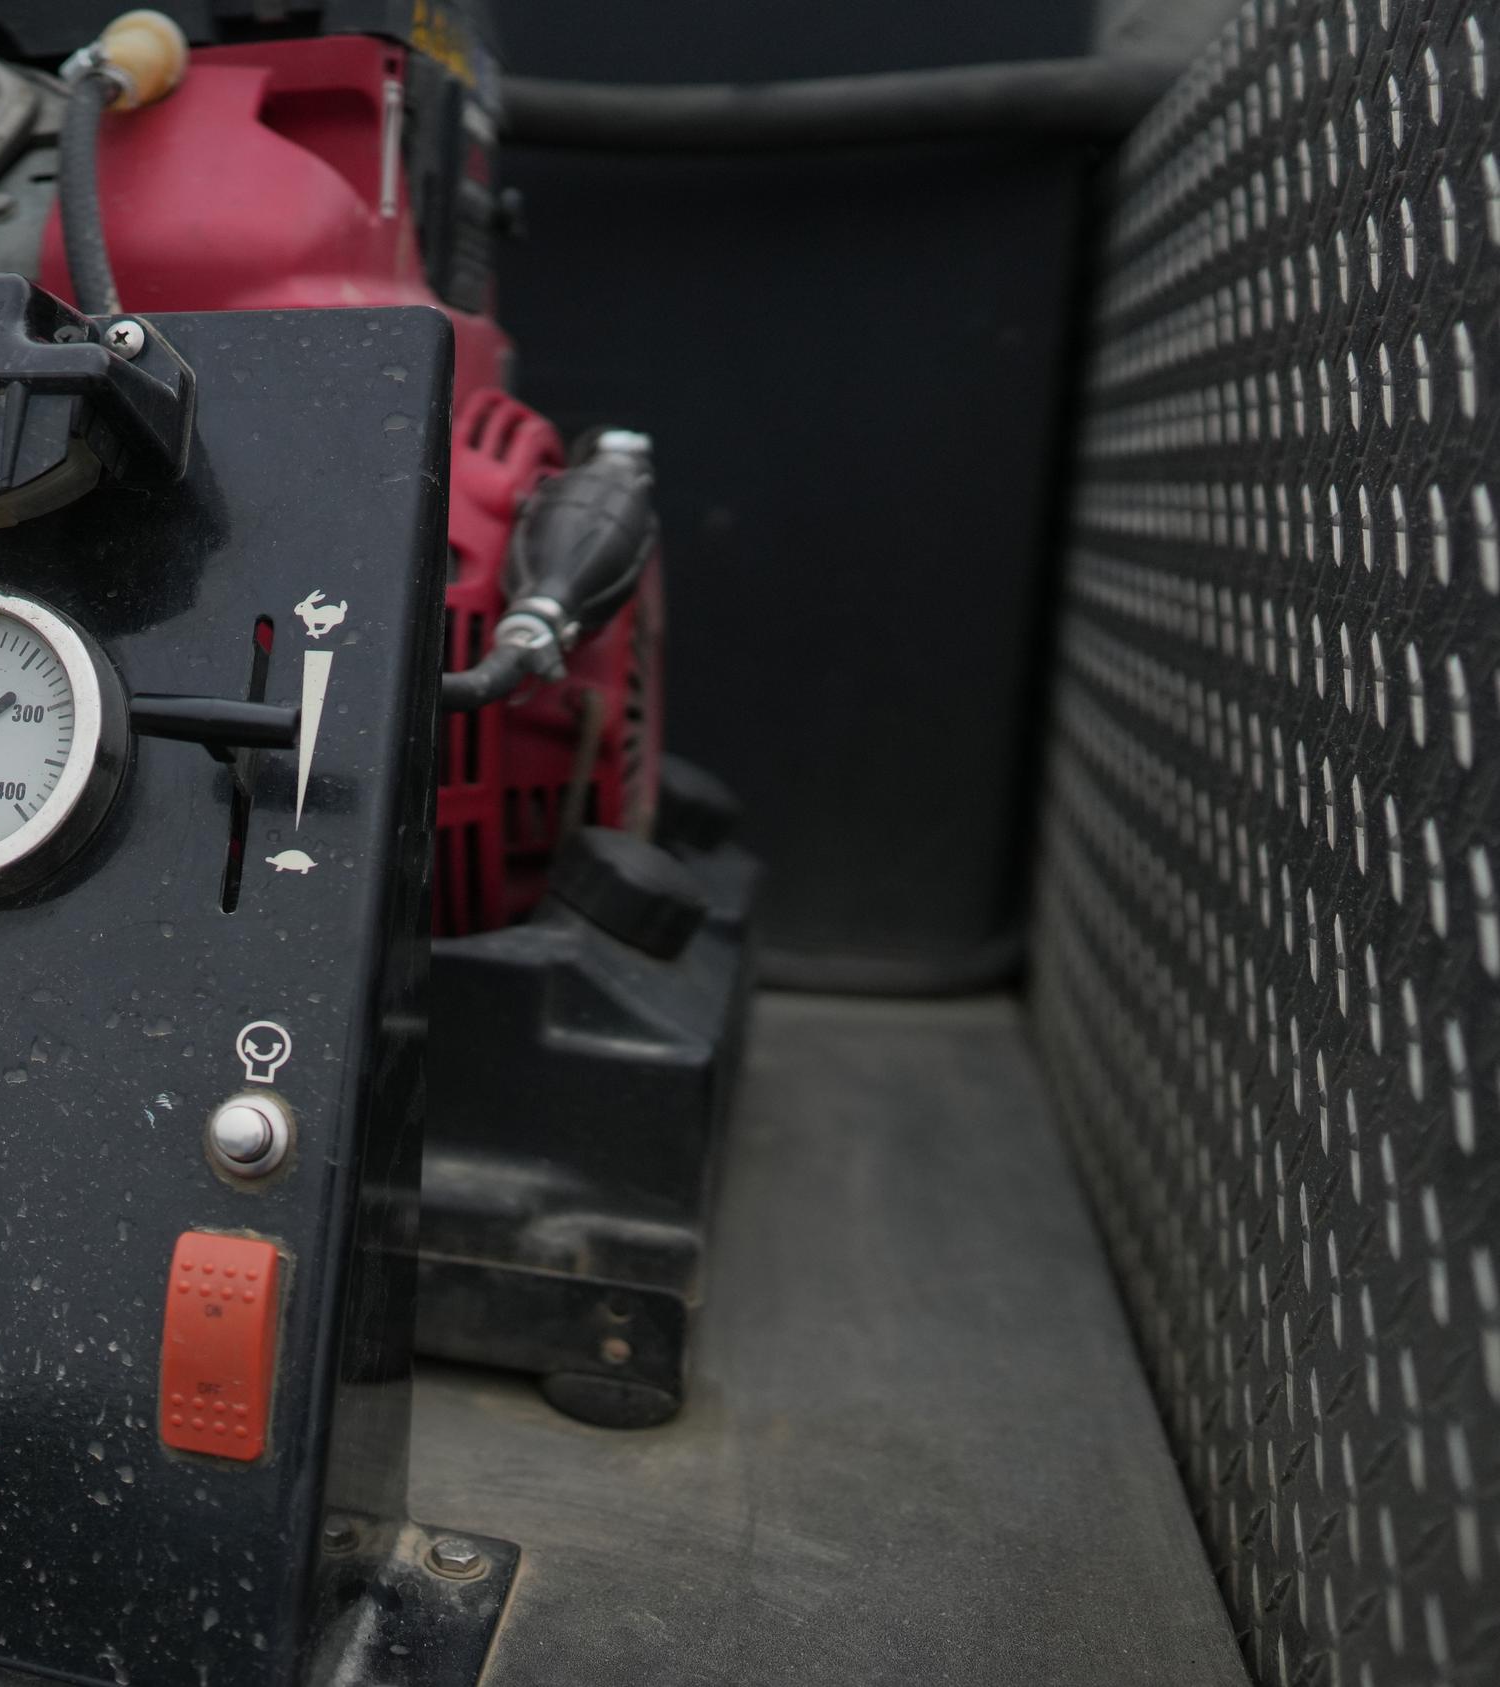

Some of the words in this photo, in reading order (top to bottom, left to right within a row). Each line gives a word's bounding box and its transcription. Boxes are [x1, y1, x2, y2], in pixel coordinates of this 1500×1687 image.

[11, 704, 44, 723] 300
[205, 1304, 222, 1318] ON
[197, 1382, 221, 1395] OFF
